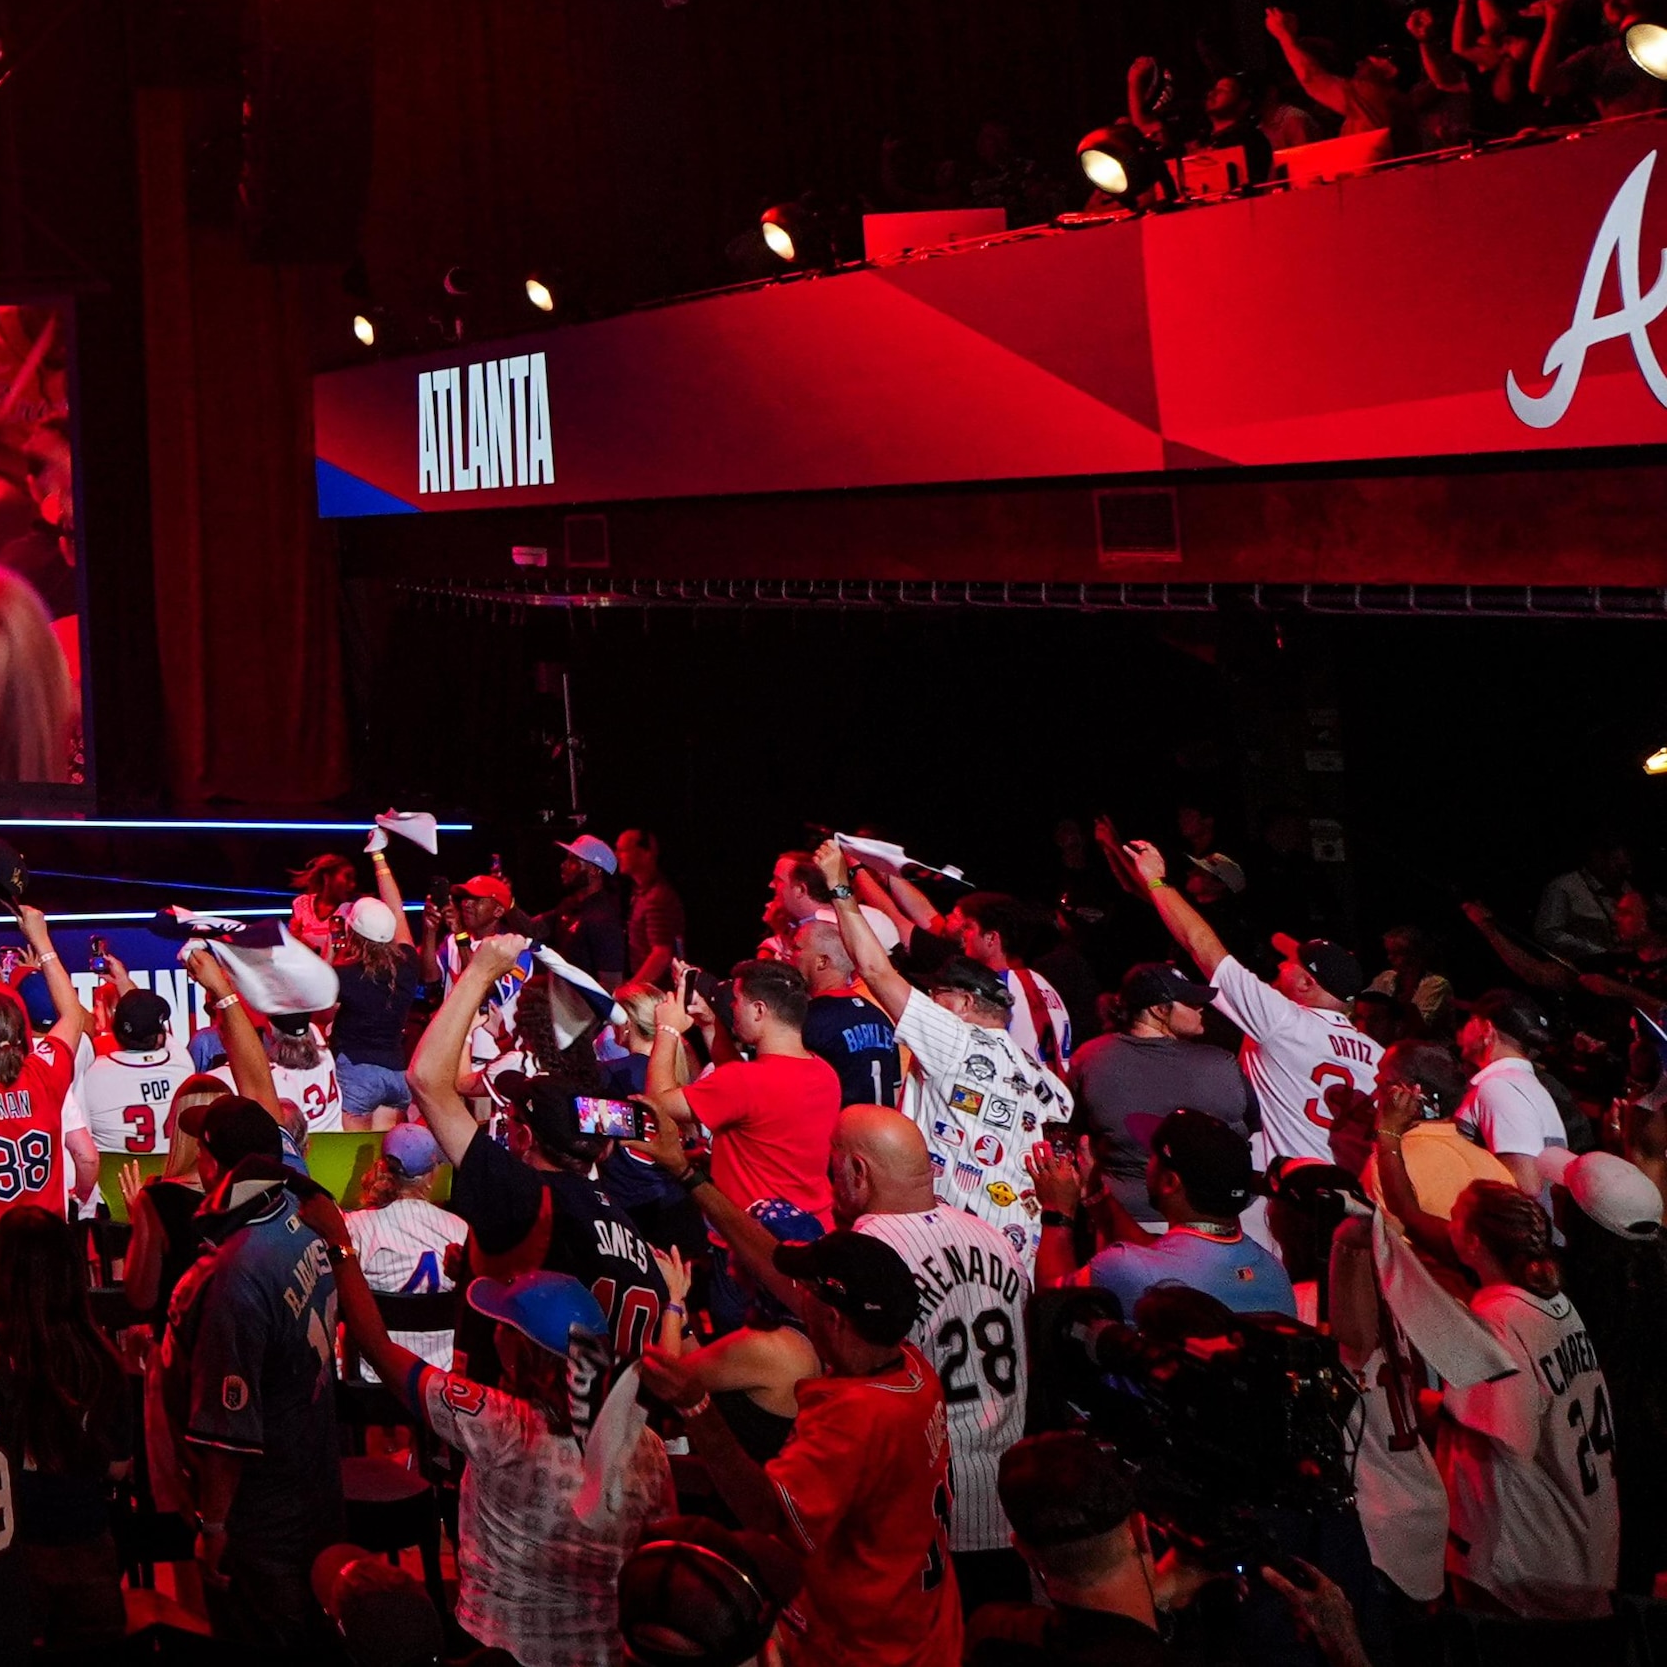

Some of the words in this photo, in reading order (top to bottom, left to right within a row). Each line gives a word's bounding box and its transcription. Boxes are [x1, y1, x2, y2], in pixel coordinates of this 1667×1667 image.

[418, 352, 555, 494] ATLANTA
[1328, 1034, 1373, 1066] ORTIZ
[140, 1079, 171, 1103] POP
[303, 1072, 339, 1121] 34
[938, 1307, 1018, 1404] 28
